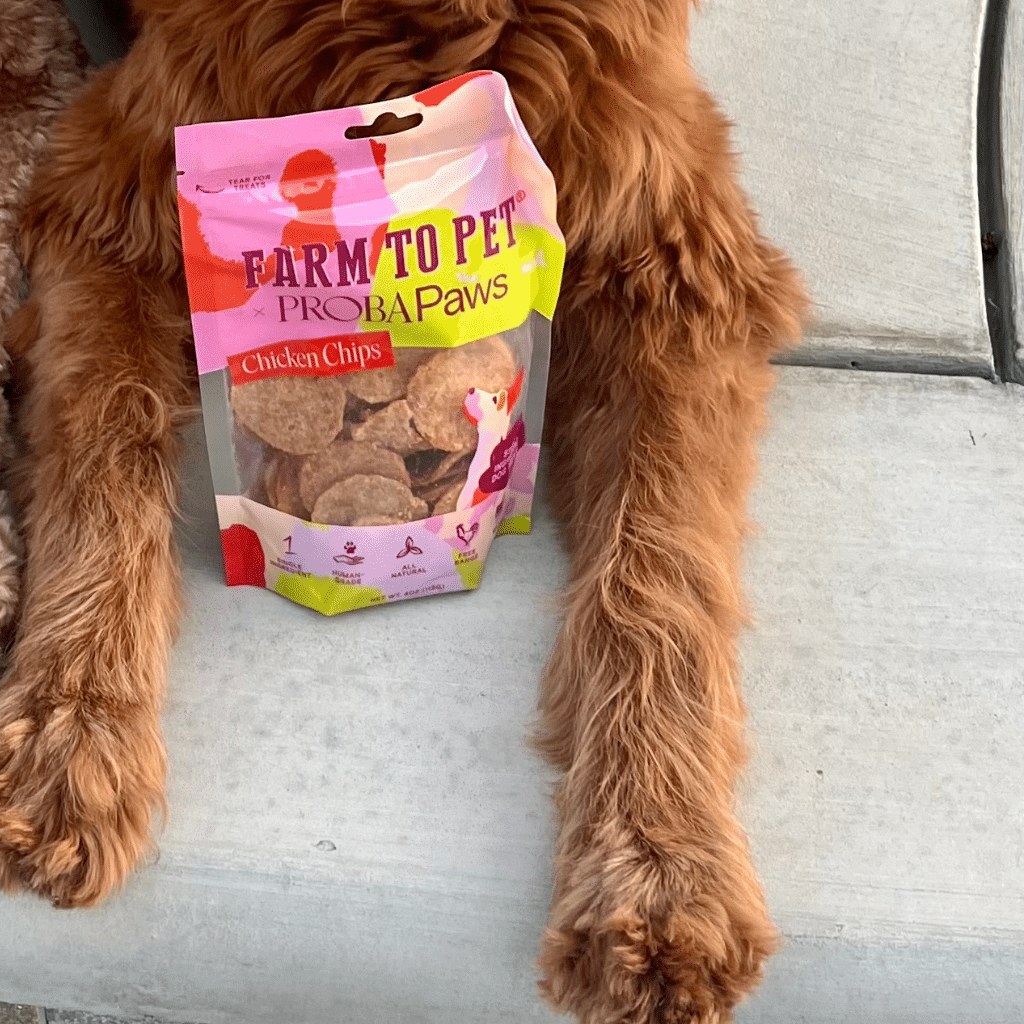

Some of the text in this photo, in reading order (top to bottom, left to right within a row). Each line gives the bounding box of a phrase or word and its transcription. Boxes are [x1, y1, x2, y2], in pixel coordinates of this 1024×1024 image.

[252, 174, 271, 182] FOR
[233, 181, 266, 190] TREATS
[241, 237, 371, 290] FARM
[385, 223, 439, 280] TO
[241, 341, 382, 375] Chicken Chips
[282, 535, 297, 555] 1
[401, 563, 417, 571] ALL
[391, 568, 427, 578] NATURAL
